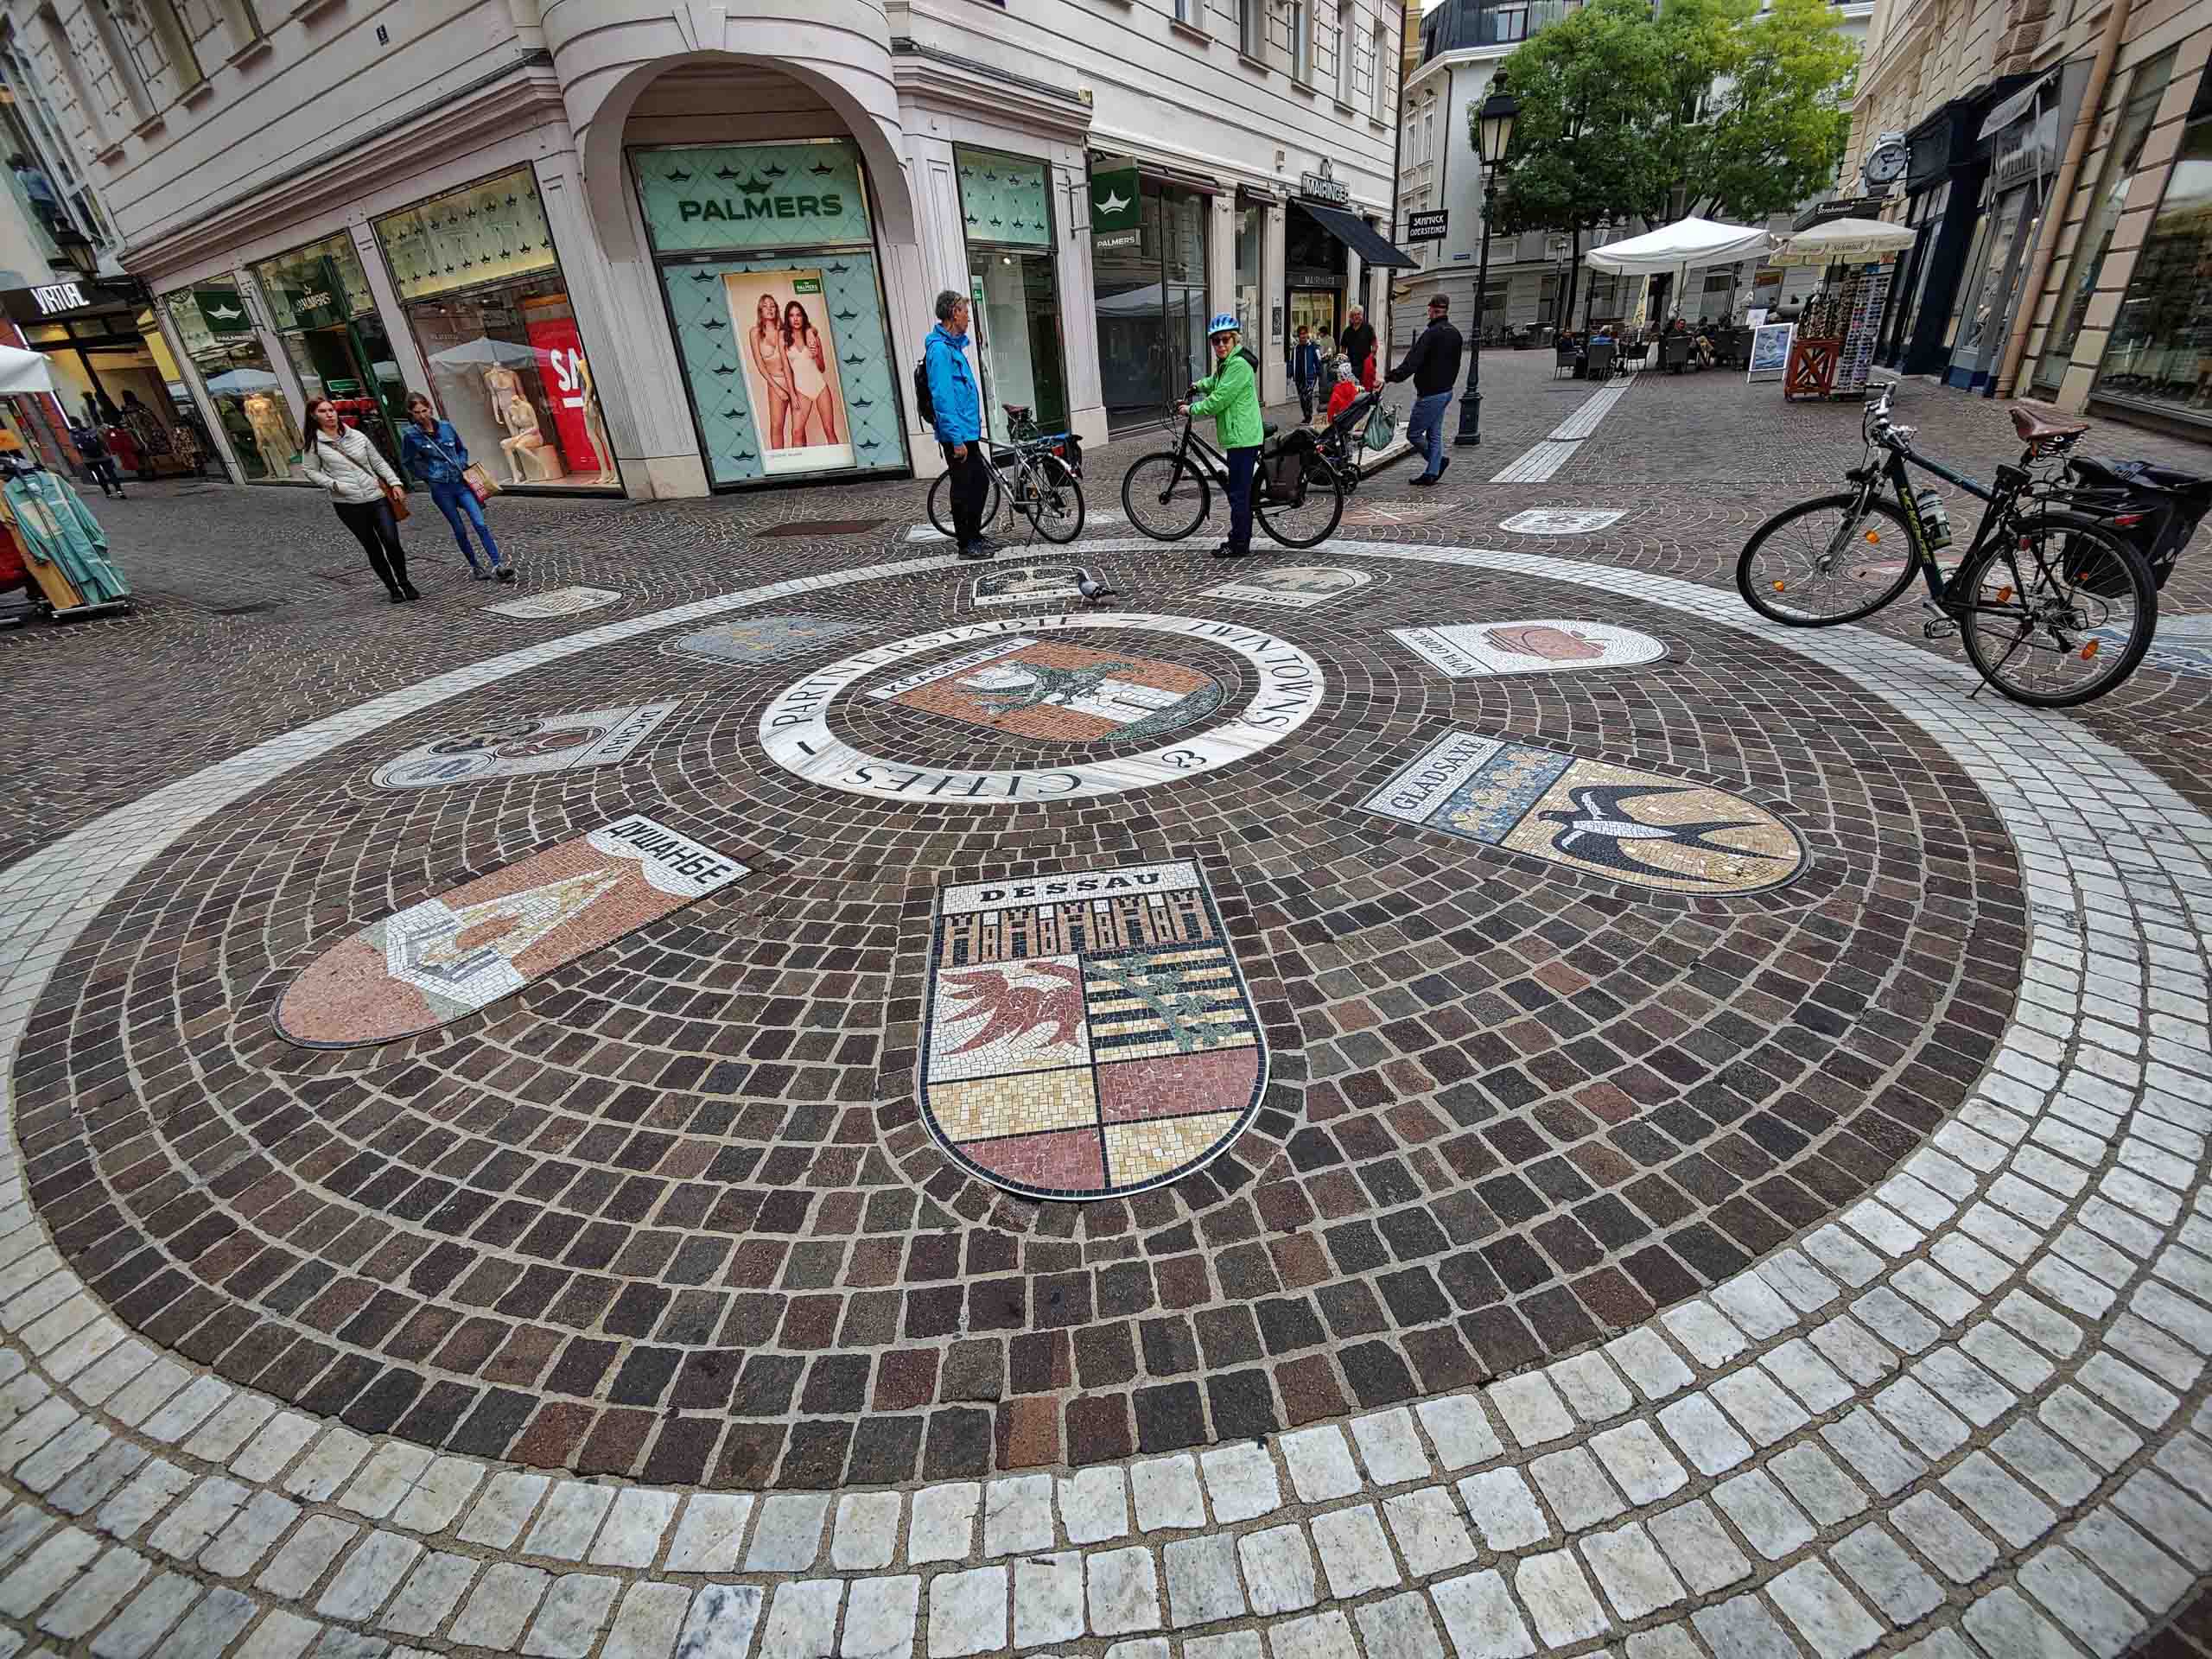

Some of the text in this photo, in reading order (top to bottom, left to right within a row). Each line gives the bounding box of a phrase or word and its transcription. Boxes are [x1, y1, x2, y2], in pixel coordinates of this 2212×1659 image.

[678, 194, 842, 222] PALMERS
[1097, 236, 1135, 248] PALMERS
[30, 283, 90, 315] VIRTUAL
[1217, 591, 1303, 604] GORIZIA
[1188, 622, 1273, 652] TWIN
[1403, 628, 1481, 675] NOVA GORICA
[883, 642, 1024, 693] KLAGENFURT
[1251, 654, 1313, 728] TOWNS
[599, 709, 663, 754] DACHAU
[842, 766, 1082, 796] CITIES
[1390, 739, 1487, 810] GLADSAXE
[980, 873, 1160, 902] DESSAU
